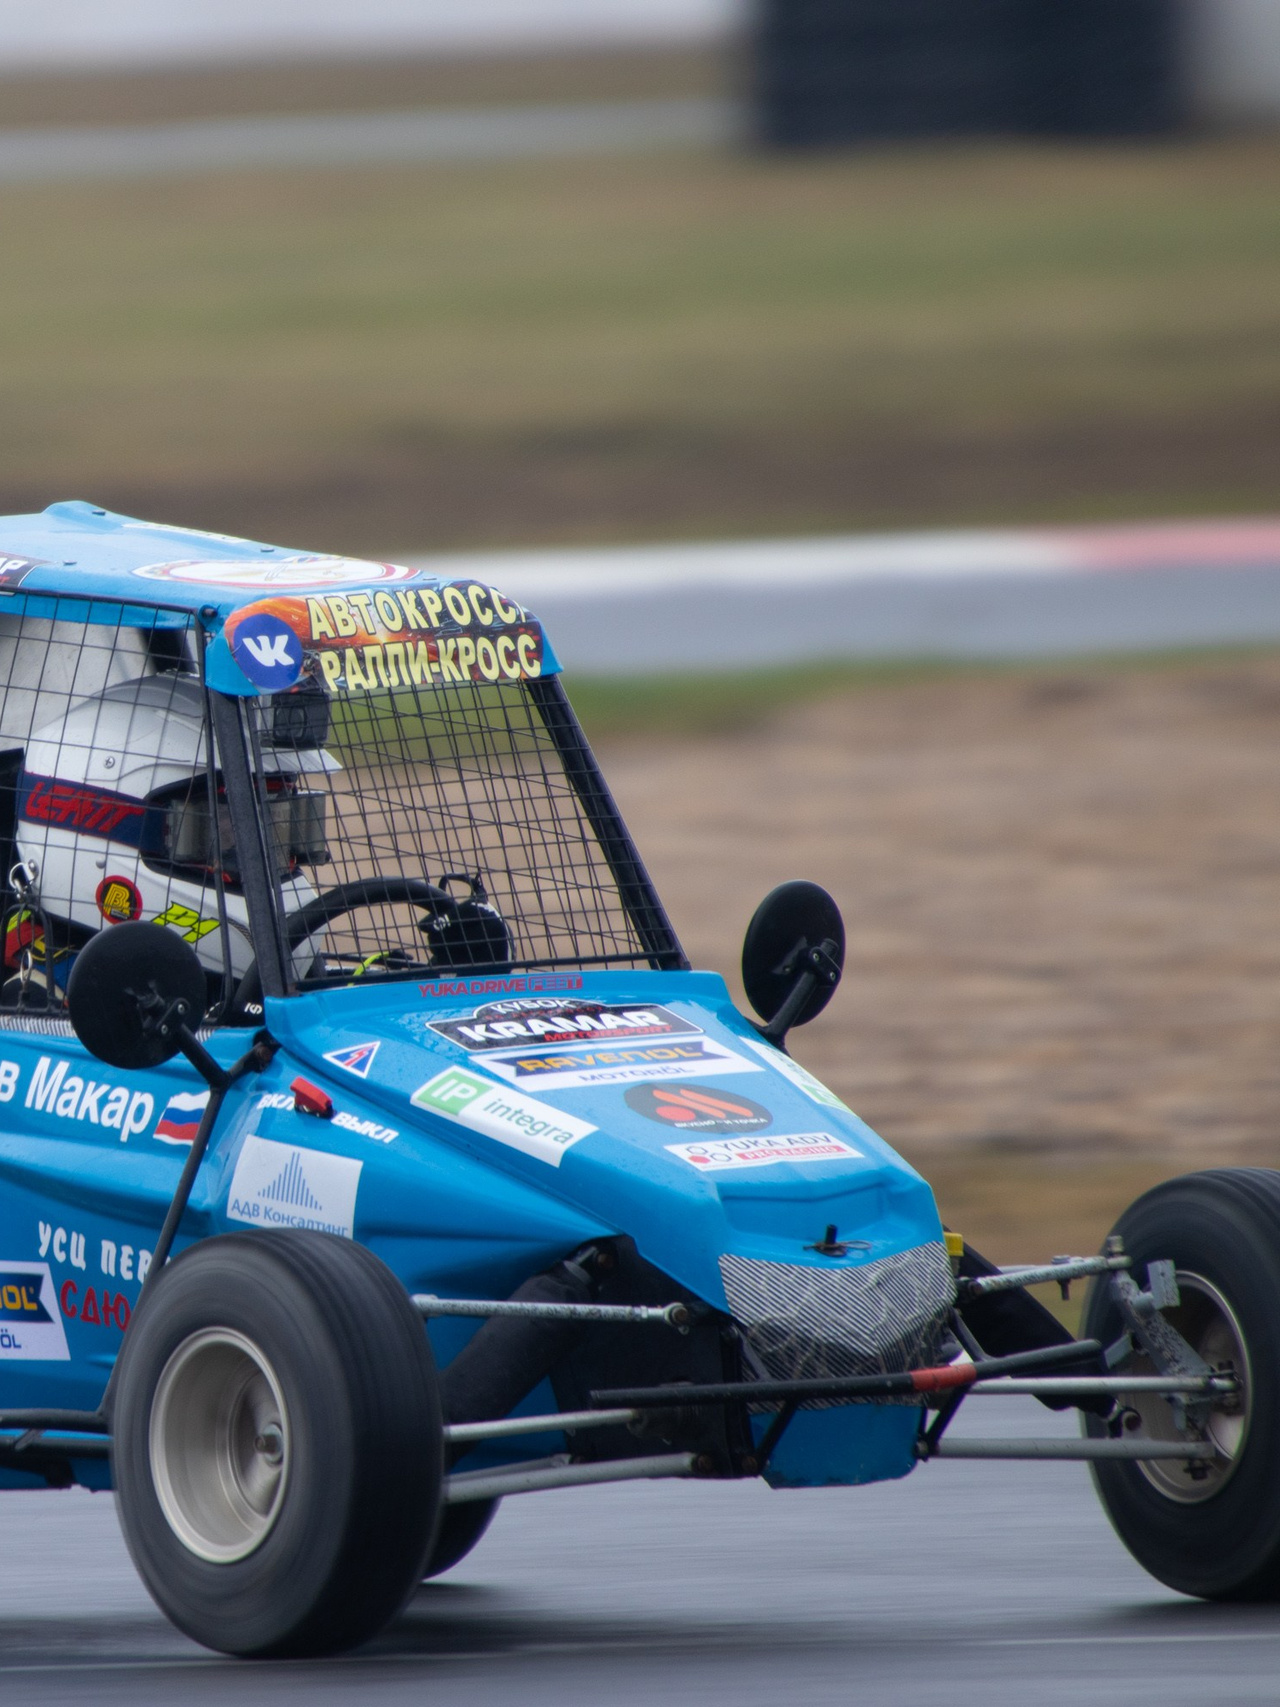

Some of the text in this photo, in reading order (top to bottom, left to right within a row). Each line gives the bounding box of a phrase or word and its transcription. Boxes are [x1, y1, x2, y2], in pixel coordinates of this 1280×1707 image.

[242, 634, 295, 667] VK
[320, 633, 541, 692] РАЛЛИ-КРОСС
[24, 781, 146, 833] LEATT
[418, 981, 469, 998] YUKA
[470, 978, 527, 995] DRIVE
[491, 999, 578, 1015] КУБОК
[457, 1010, 670, 1043] KRAMAR
[543, 1025, 673, 1042] MOTORSPORT
[516, 1046, 704, 1073] RAVENOL
[24, 1056, 154, 1143] Макар
[431, 1078, 574, 1145] IP integra
[330, 1111, 400, 1144] ВЫКЛ
[716, 1134, 832, 1153] YUKA ADV
[231, 1198, 349, 1237] АДВ Консалтинг
[38, 1220, 171, 1286] УСЦ ПЕР
